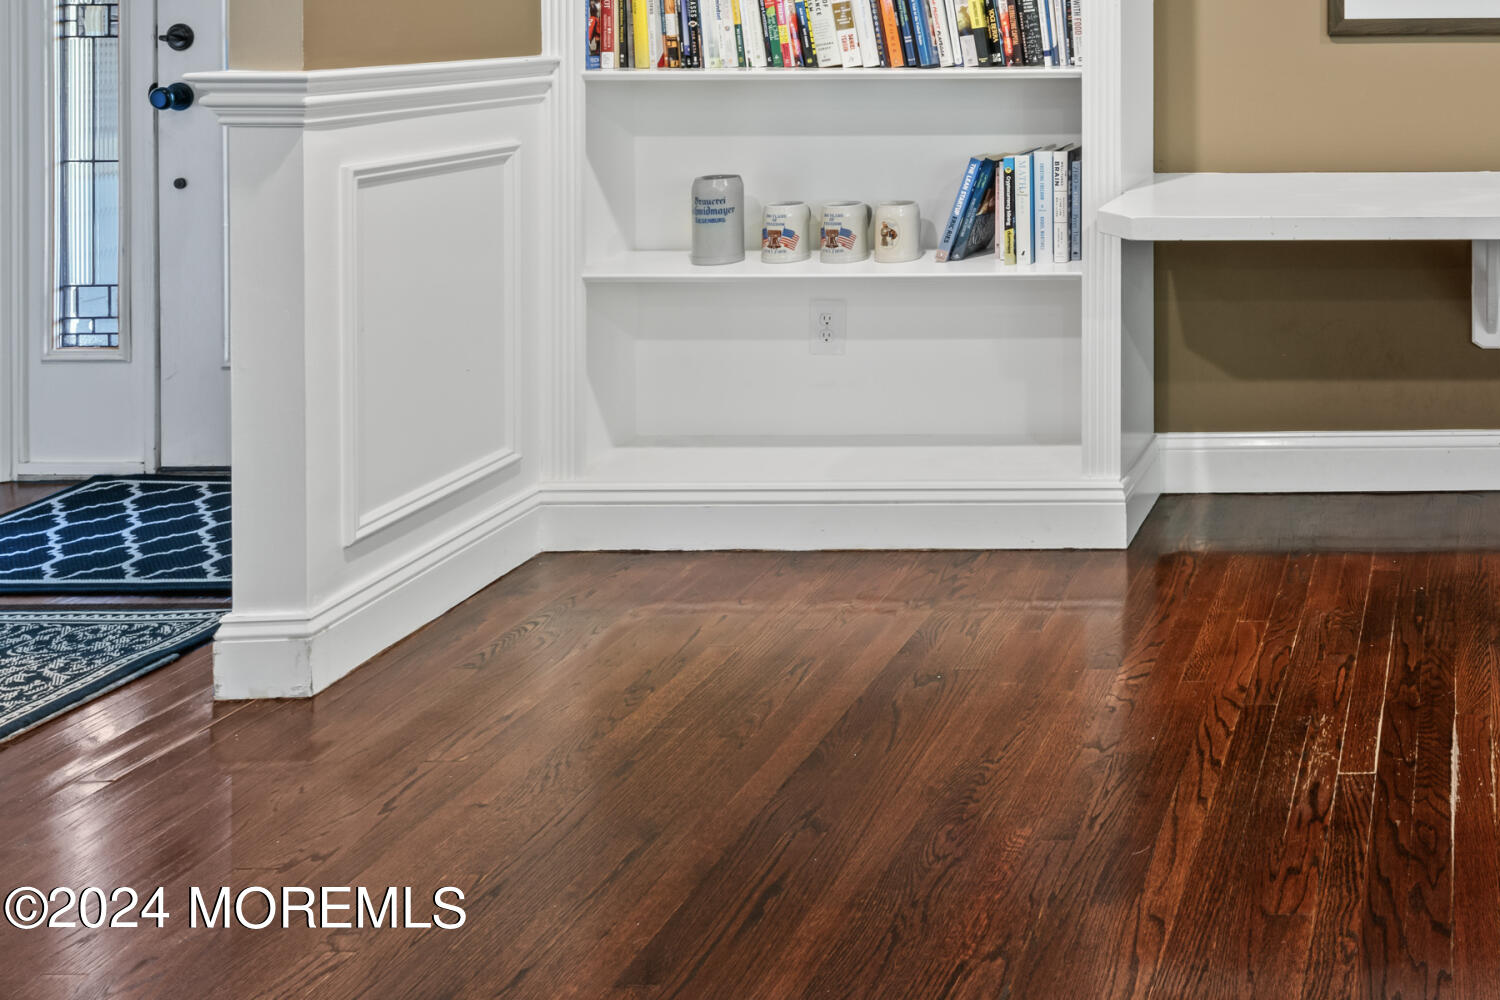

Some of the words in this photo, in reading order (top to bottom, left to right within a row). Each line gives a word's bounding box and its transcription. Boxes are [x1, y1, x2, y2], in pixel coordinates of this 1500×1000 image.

[822, 0, 828, 8] OF
[1073, 0, 1081, 16] WITH
[1074, 18, 1082, 35] FOOD
[968, 163, 977, 174] THE
[961, 175, 972, 190] LEAN
[954, 191, 967, 216] STARTUP
[948, 216, 957, 229] ERIC
[943, 230, 953, 243] RIES
